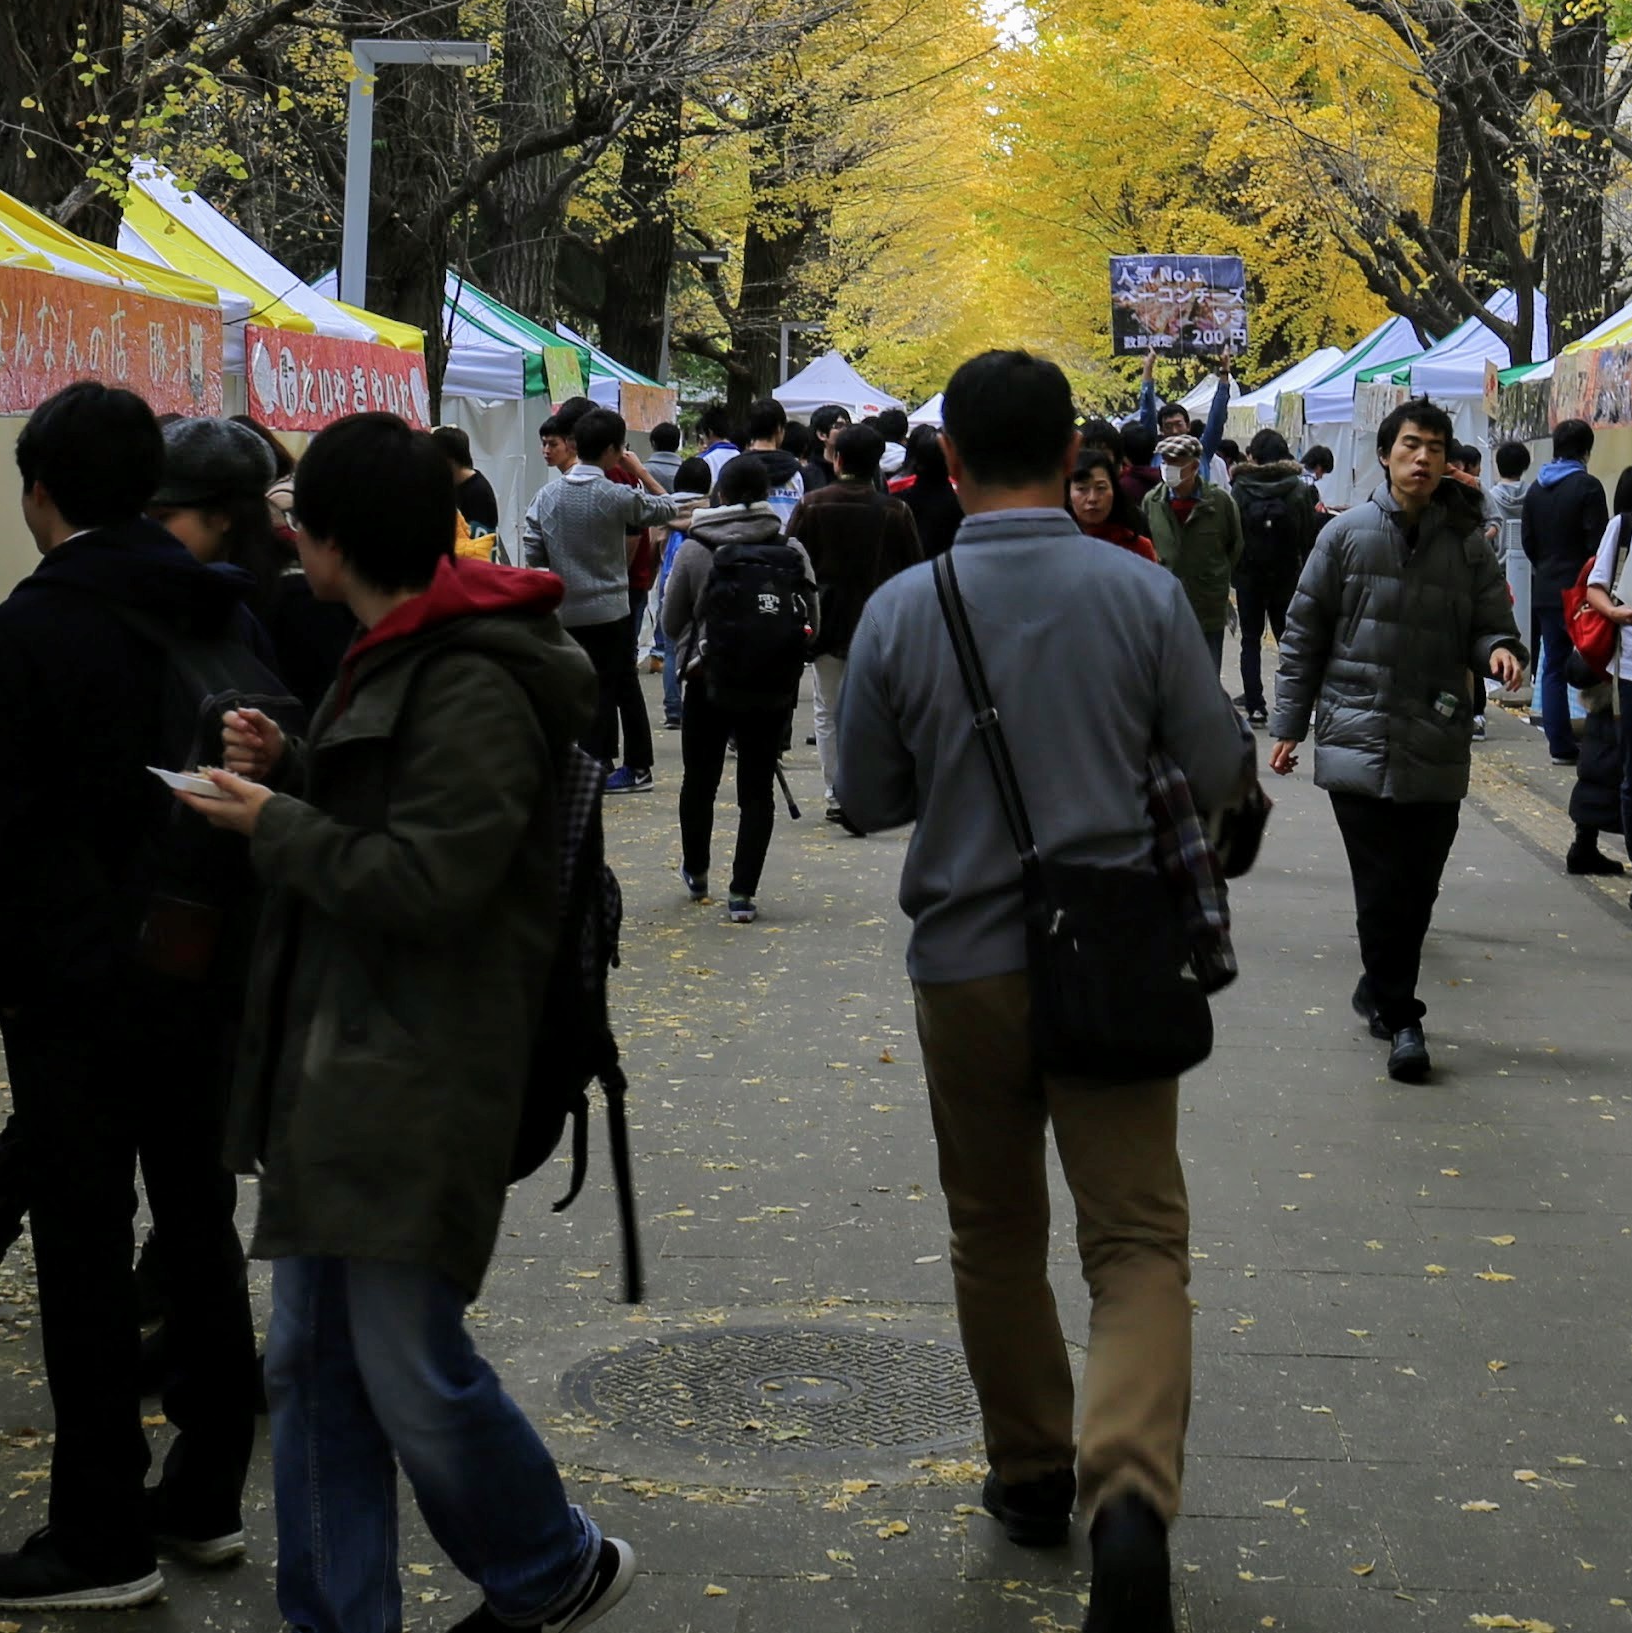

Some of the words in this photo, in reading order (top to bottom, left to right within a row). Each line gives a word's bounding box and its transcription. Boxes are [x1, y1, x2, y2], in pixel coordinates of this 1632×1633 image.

[1118, 266, 1154, 285] 人気
[1118, 286, 1245, 304] ベーコンチーズ
[1212, 308, 1246, 329] やき
